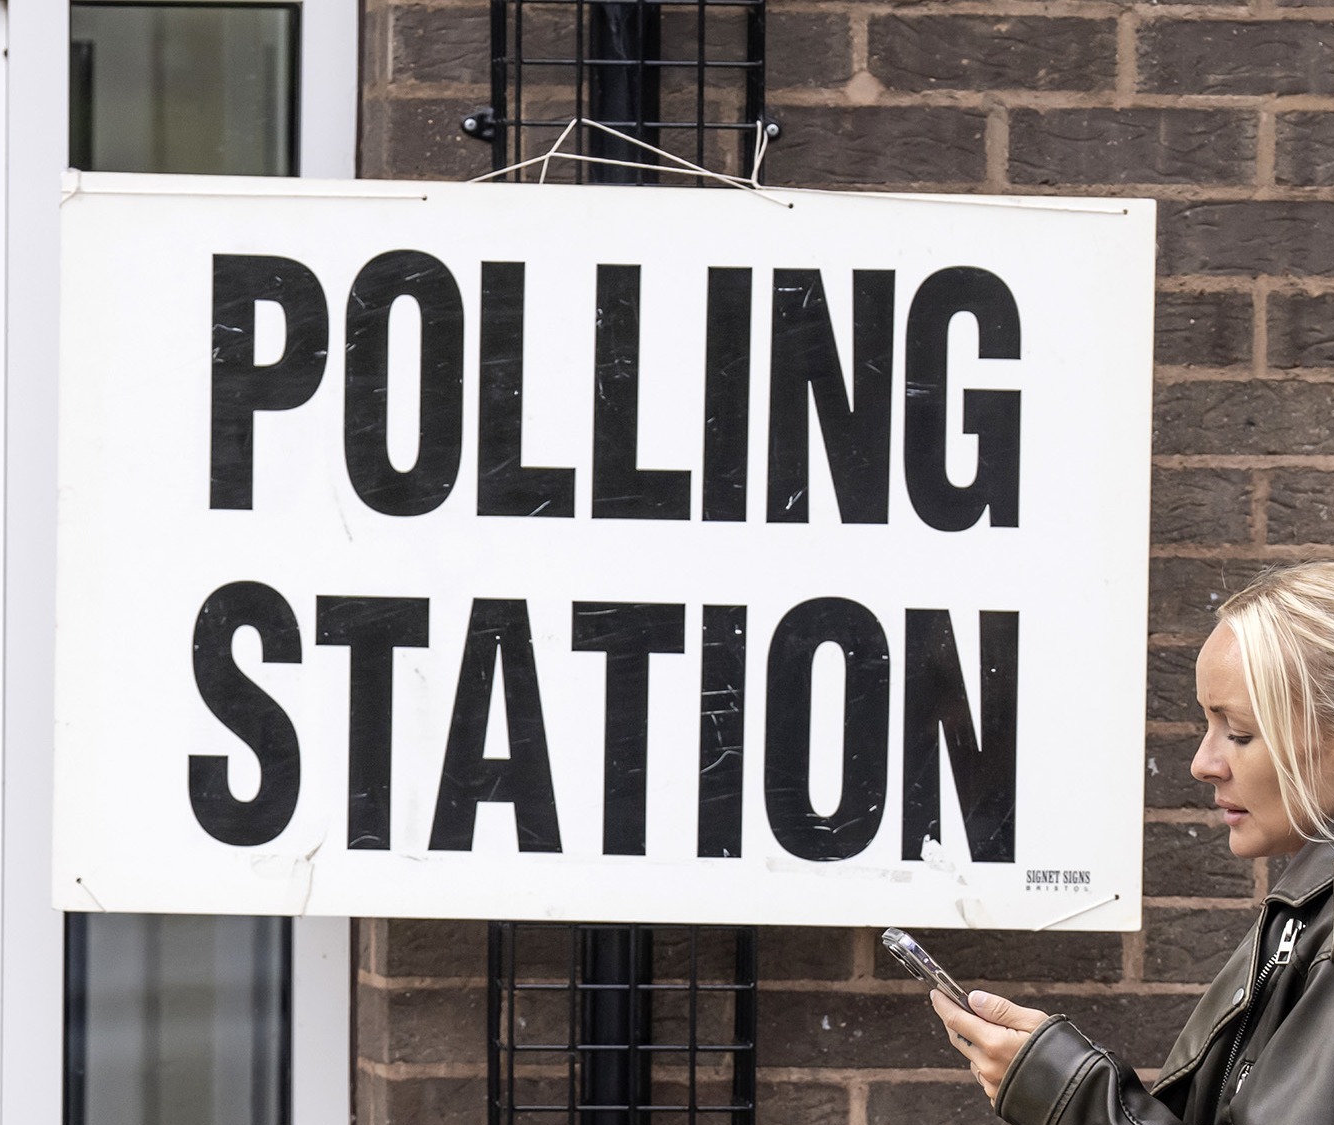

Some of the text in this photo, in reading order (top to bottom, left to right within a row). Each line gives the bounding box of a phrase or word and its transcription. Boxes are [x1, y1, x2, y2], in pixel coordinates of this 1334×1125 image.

[209, 248, 1022, 533] POLLING
[187, 579, 1020, 865] STATION
[1026, 869, 1091, 885] SIGNET SIGNS
